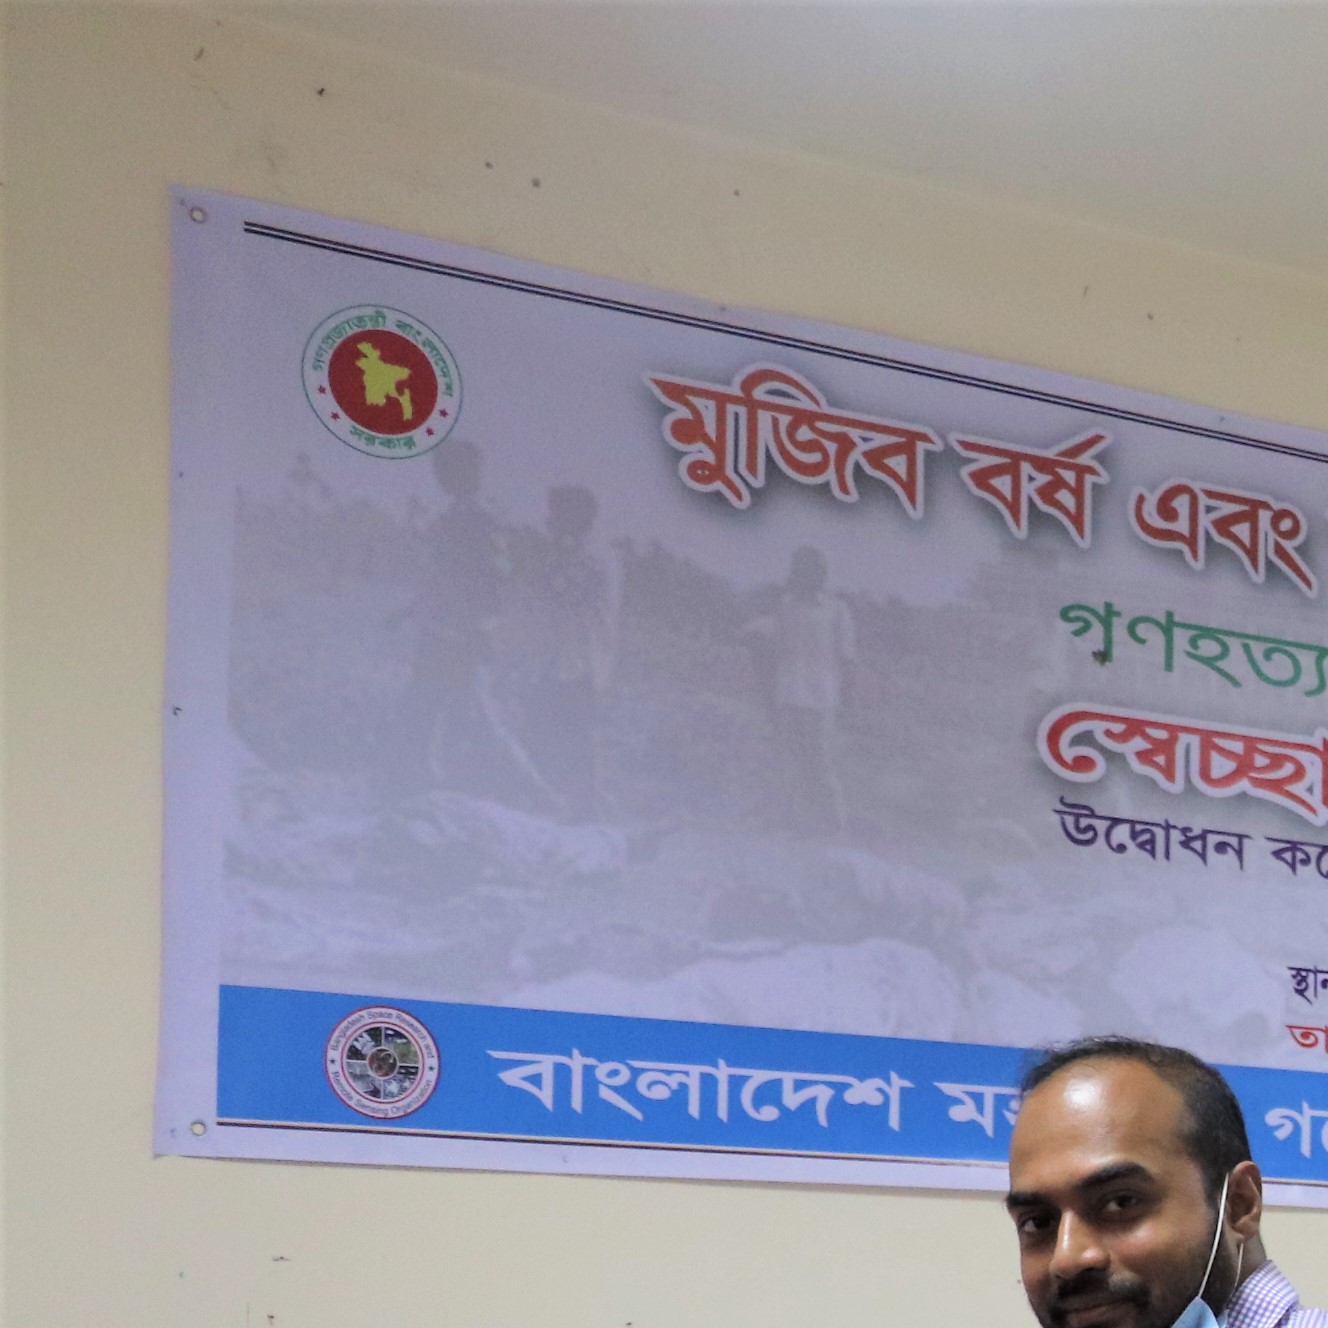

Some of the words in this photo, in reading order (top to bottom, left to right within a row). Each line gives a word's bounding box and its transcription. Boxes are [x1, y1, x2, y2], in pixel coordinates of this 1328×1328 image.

[653, 370, 934, 504] মুজিব
[955, 435, 1108, 540] বর্ষ
[1136, 486, 1314, 590] এবং
[1055, 797, 1254, 872] উদ্বোধন
[485, 1047, 915, 1132] বাংলাদেশ
